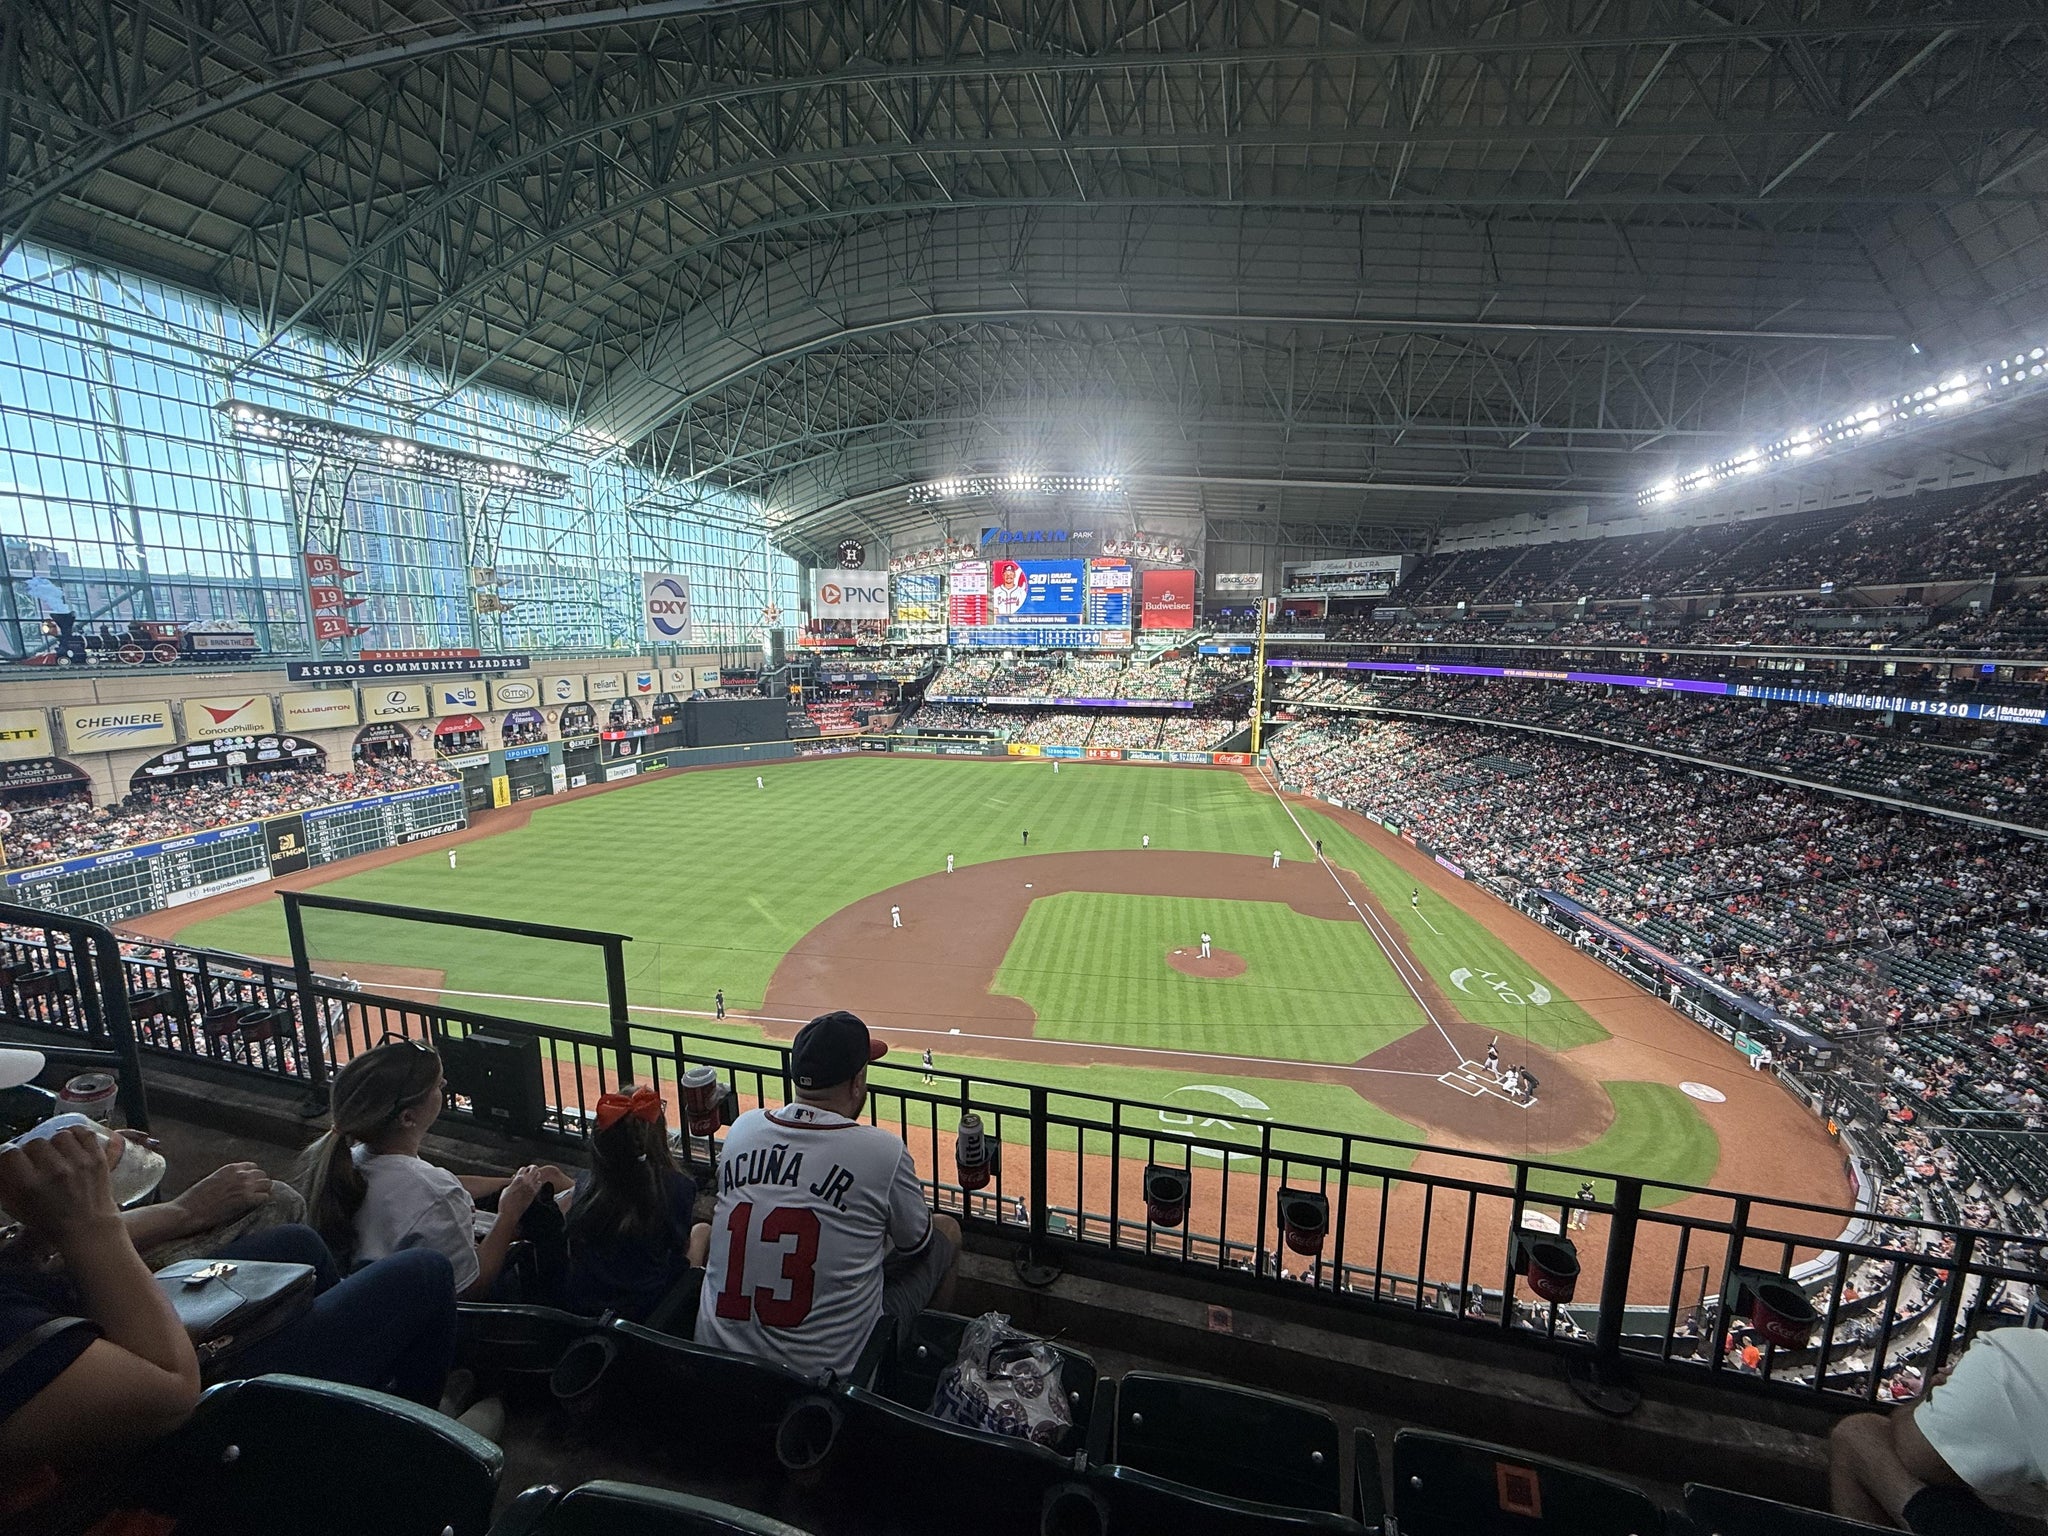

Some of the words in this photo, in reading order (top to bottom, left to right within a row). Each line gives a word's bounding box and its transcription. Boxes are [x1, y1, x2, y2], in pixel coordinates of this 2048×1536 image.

[1000, 530, 1069, 544] DAIKIN
[1073, 531, 1094, 539] PARK
[846, 550, 857, 560] H
[314, 559, 332, 572] 05
[1028, 574, 1047, 584] 30
[319, 591, 338, 603] 19
[843, 586, 885, 603] PNC
[650, 600, 687, 614] OXY
[1145, 602, 1190, 610] Budweiser
[323, 621, 340, 632] 21
[301, 664, 366, 677] ASTROS
[373, 660, 464, 673] COMMUNITY
[469, 658, 522, 668] LEADERS
[594, 679, 617, 689] reliant
[457, 688, 476, 699] slb
[502, 688, 529, 698] COTTON
[289, 704, 350, 714] HALLIBURTON
[374, 705, 420, 716] LEXUS
[2001, 707, 2046, 718] BALDWIN
[76, 713, 163, 728] CHENIERE
[198, 724, 264, 736] ConocoPhillips
[508, 747, 547, 758] 1POINTFIVE
[1219, 755, 1244, 763] Coca-Cola
[7, 768, 54, 778] LANDRY'S
[220, 826, 250, 838] GEICO
[407, 823, 458, 841] NITTOTIRE.COM
[162, 838, 196, 850] GEICO
[96, 851, 134, 865] GEICO
[272, 847, 305, 861] BETMGM
[21, 866, 64, 880] GEICO
[36, 882, 52, 890] MIA
[151, 860, 164, 907] NATIONAL
[203, 875, 255, 894] Higginbotham
[1474, 968, 1526, 1004] OXY
[723, 1143, 804, 1198] ACUÑA
[809, 1164, 856, 1213] JR.
[714, 1201, 820, 1328] 13
